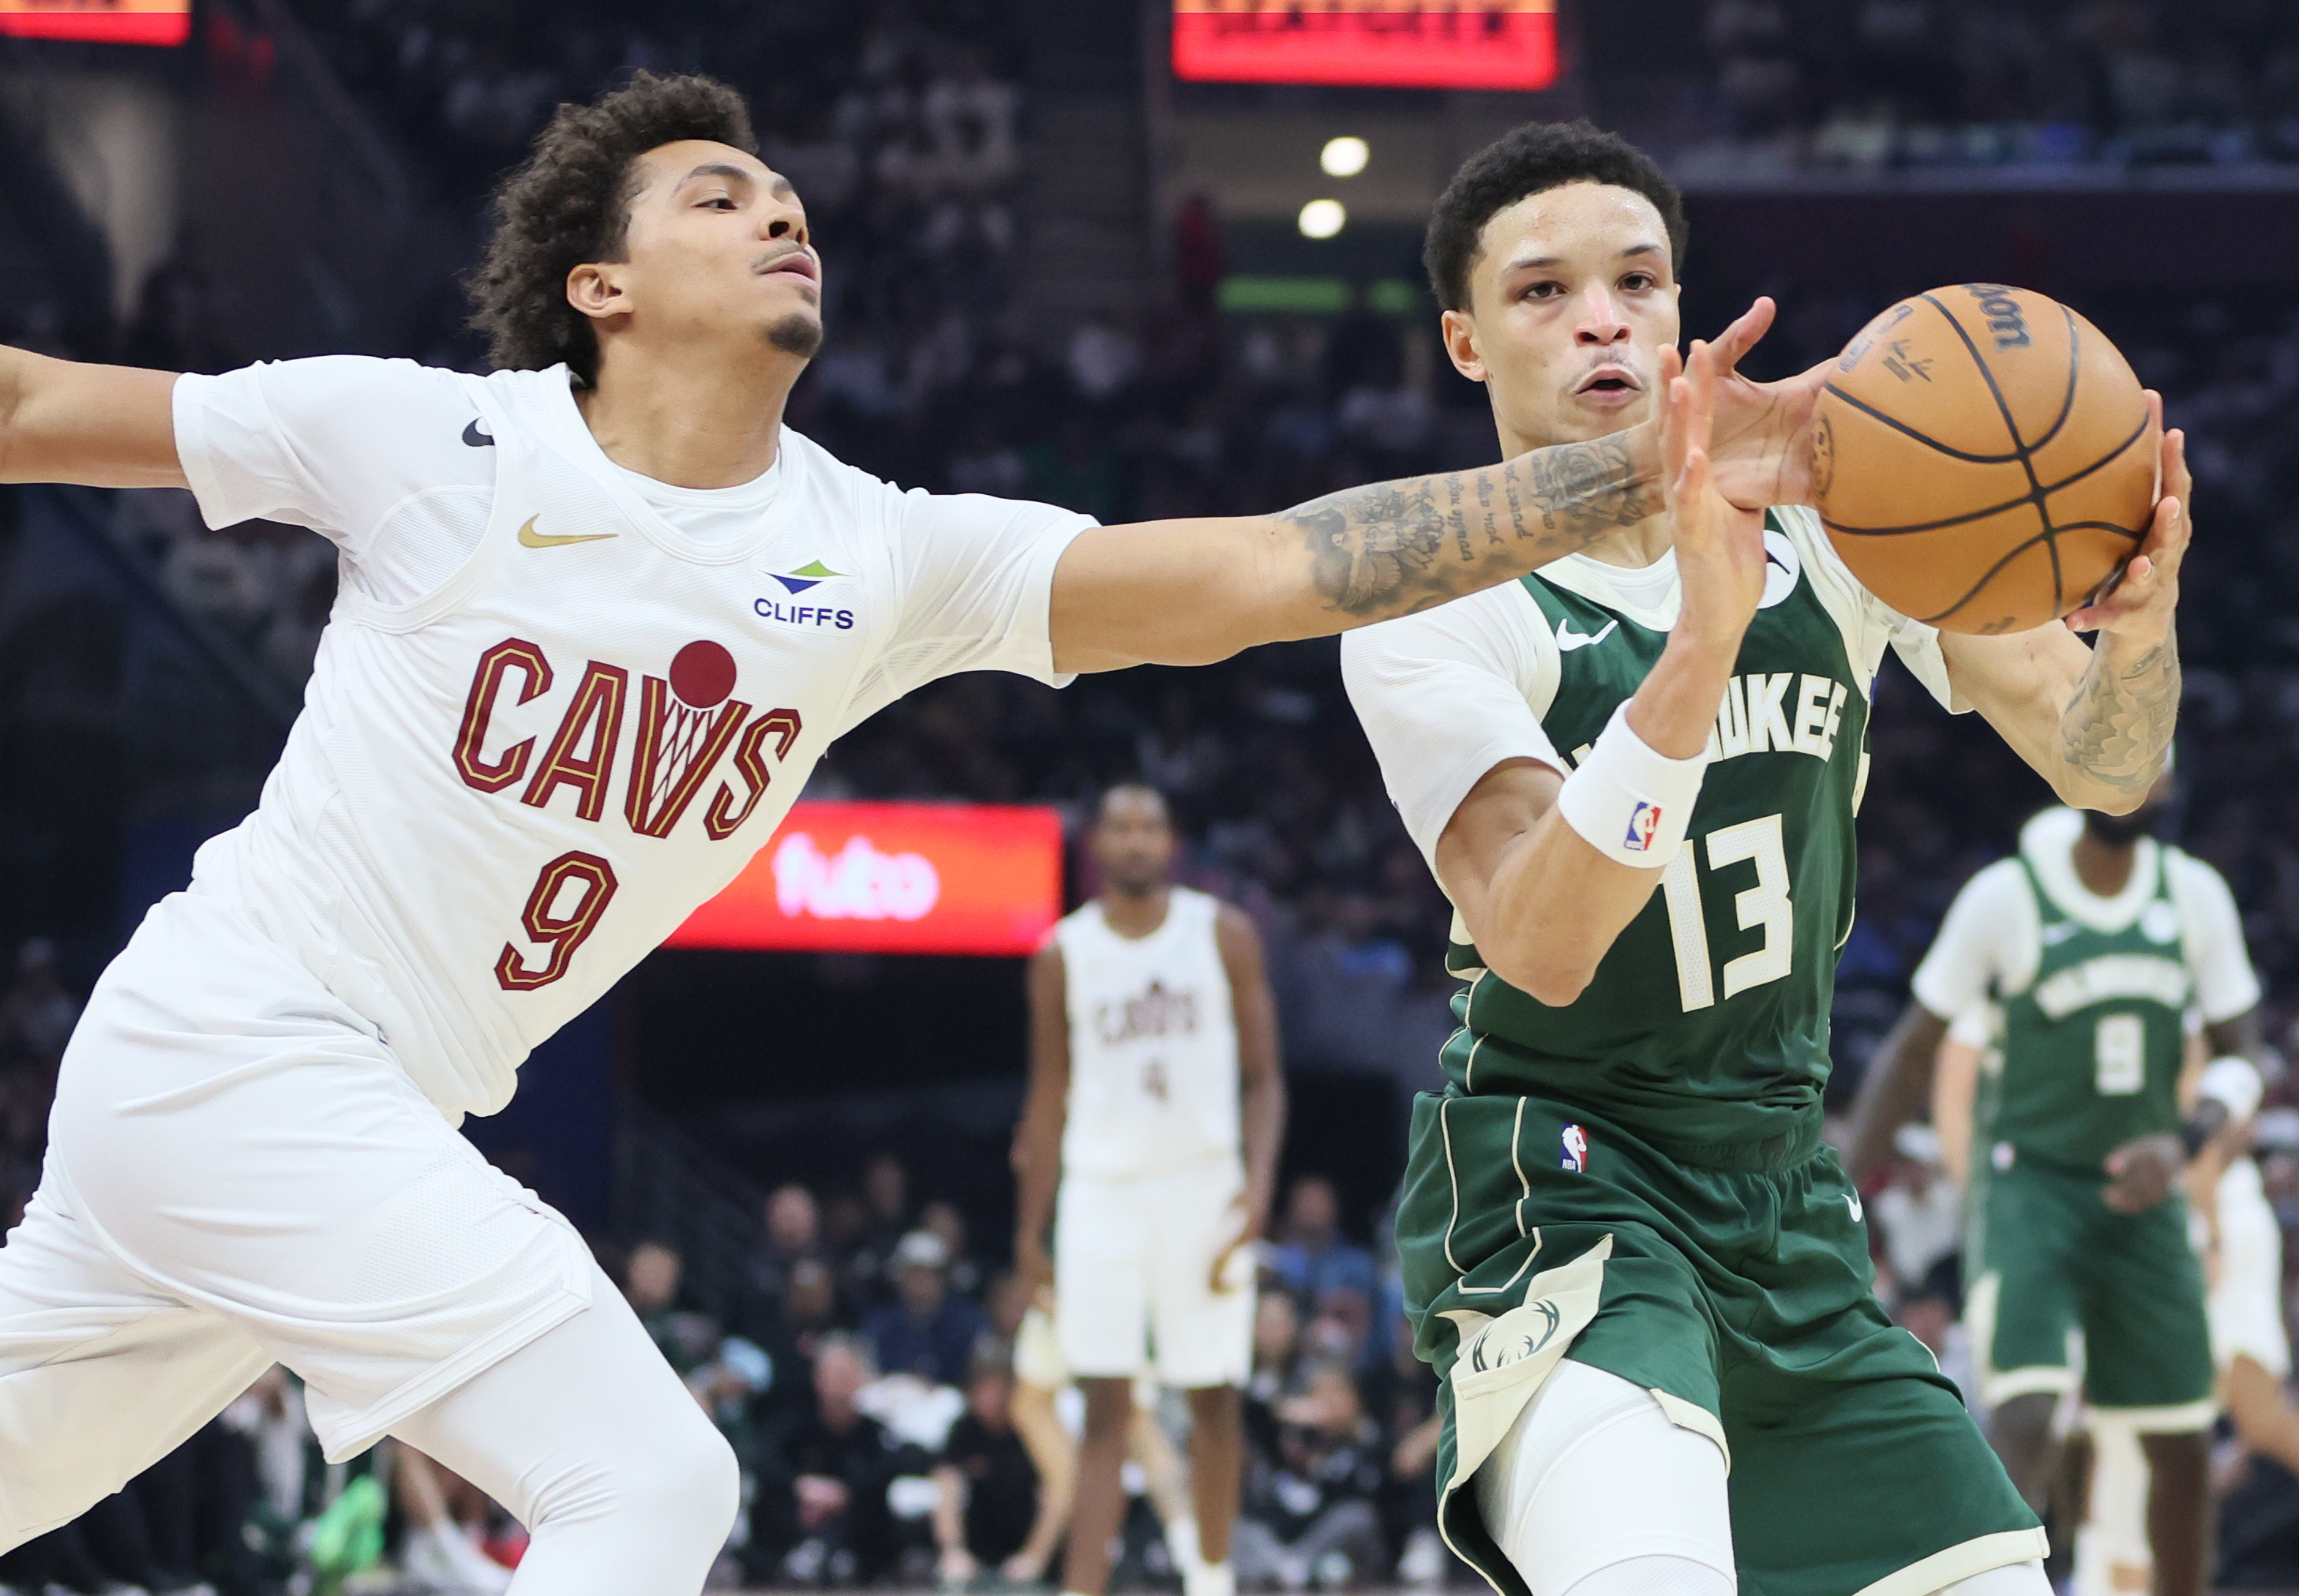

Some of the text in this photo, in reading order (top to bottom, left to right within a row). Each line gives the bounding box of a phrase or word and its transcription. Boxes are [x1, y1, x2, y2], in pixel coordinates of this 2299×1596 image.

[753, 597, 854, 631] CLIFFS
[452, 637, 802, 841] CAVS
[493, 849, 619, 991] 9
[1658, 813, 1794, 1013] 13
[1562, 1159, 1576, 1171] NBA
